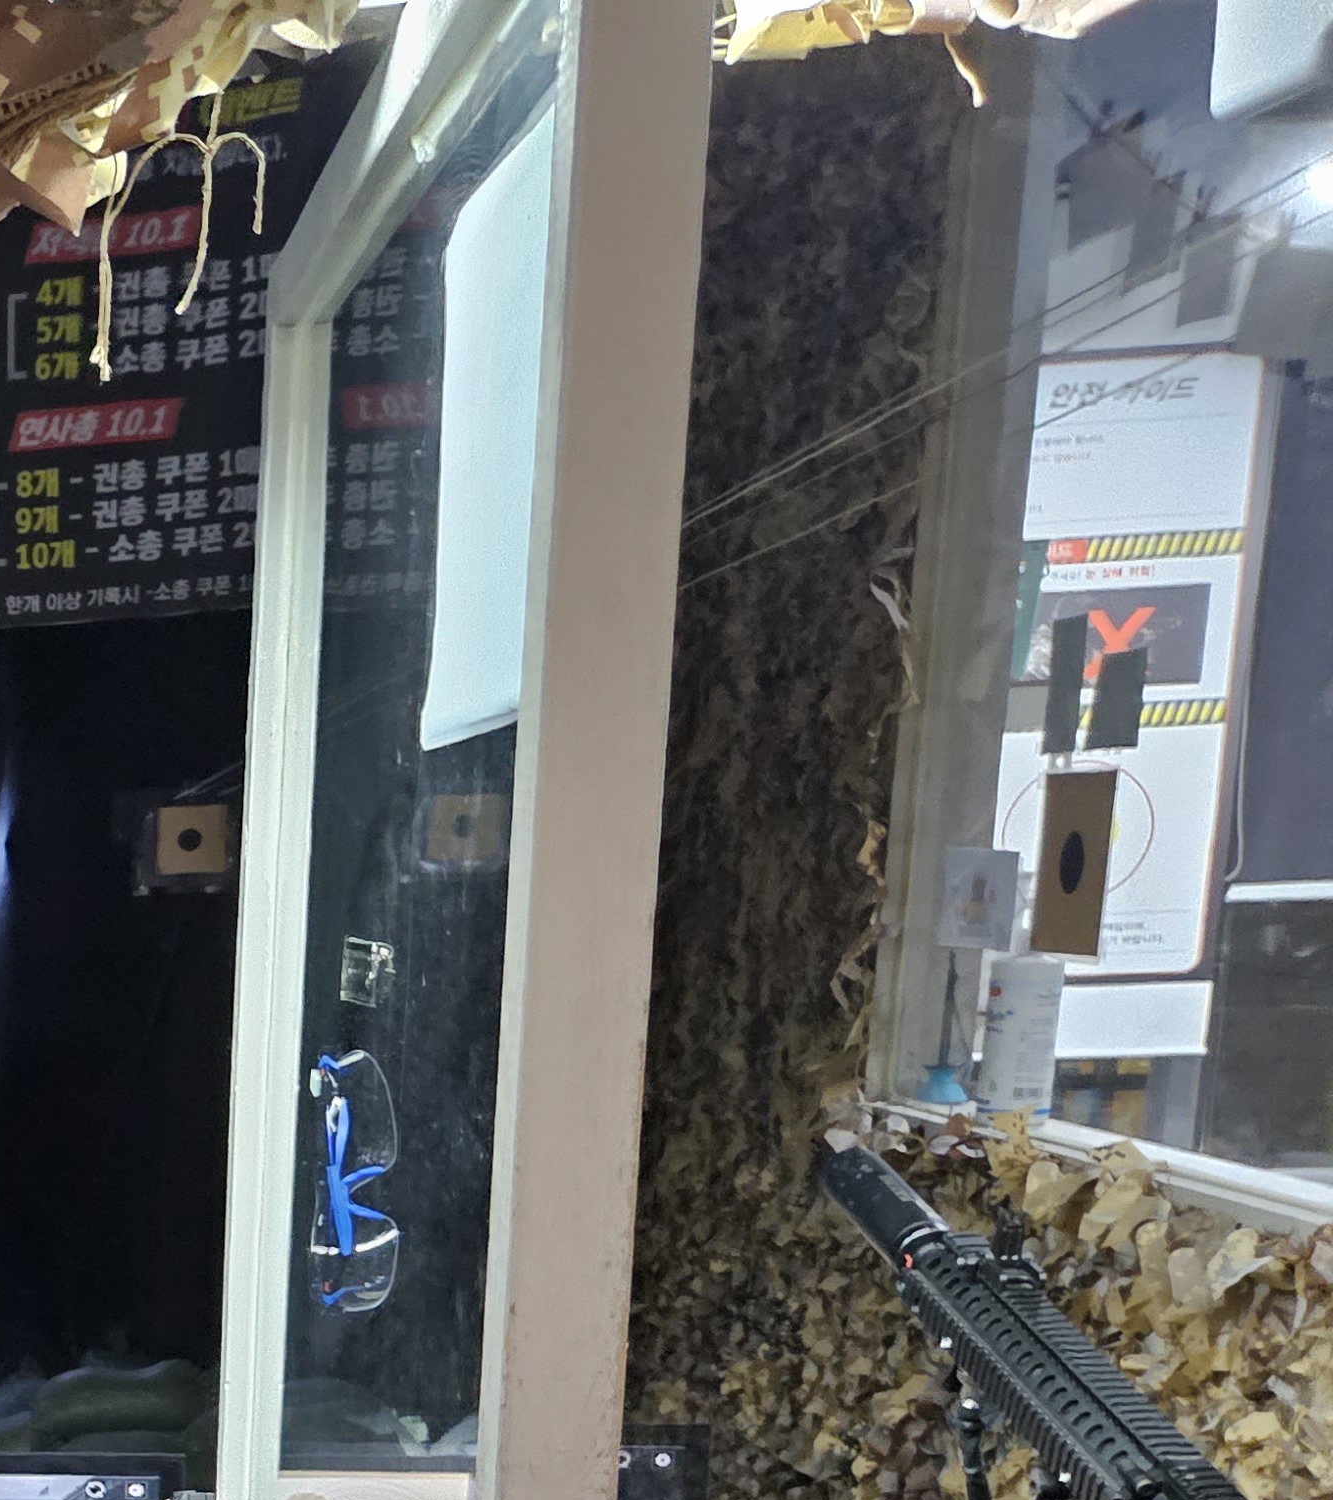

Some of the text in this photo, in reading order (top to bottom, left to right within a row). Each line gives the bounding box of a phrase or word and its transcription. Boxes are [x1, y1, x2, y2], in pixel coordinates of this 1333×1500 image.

[124, 209, 191, 247] 10.1
[35, 275, 83, 307] 4개
[36, 314, 83, 344] 5개
[35, 333, 228, 380] 6개 소총 쿠폰
[1048, 379, 1107, 409] 안전
[17, 405, 168, 448] 연사총 10.1
[16, 467, 60, 499] 8개
[92, 458, 147, 494] 권총
[156, 452, 210, 485] 쿠폰
[15, 505, 59, 534] 9개
[92, 496, 147, 530] 권총
[155, 489, 209, 522] 쿠폰
[15, 523, 226, 570] 10개 소총 쿠폰
[46, 592, 82, 611] 이상
[196, 575, 231, 596] 쿠폰
